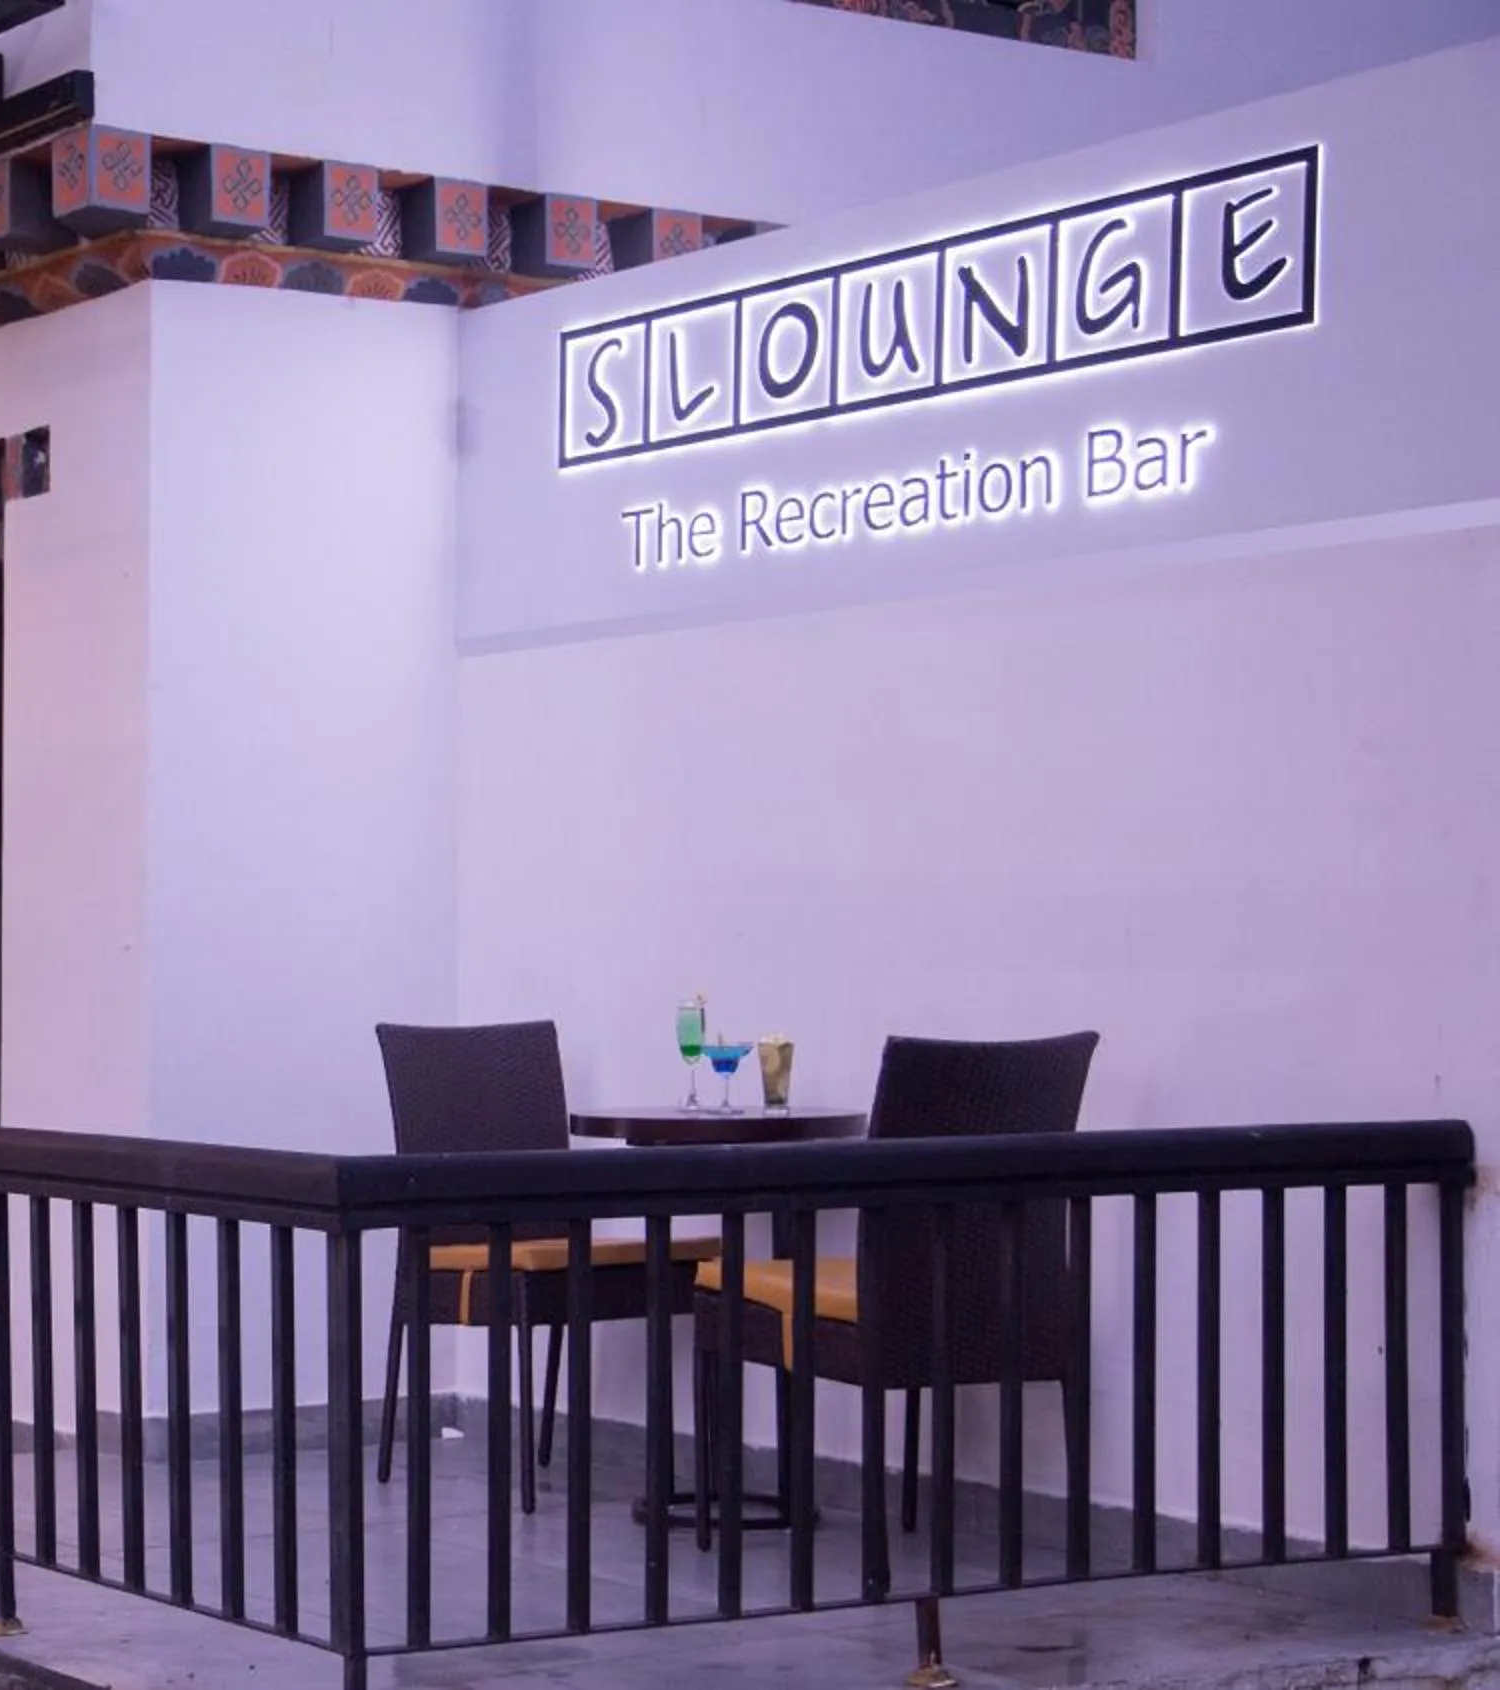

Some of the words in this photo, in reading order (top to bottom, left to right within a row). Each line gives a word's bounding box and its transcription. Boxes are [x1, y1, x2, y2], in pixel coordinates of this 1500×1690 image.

[585, 186, 1289, 448] SLOUNGE
[622, 502, 716, 568] The
[739, 451, 1052, 553] Recreation
[1085, 425, 1209, 499] Bar
